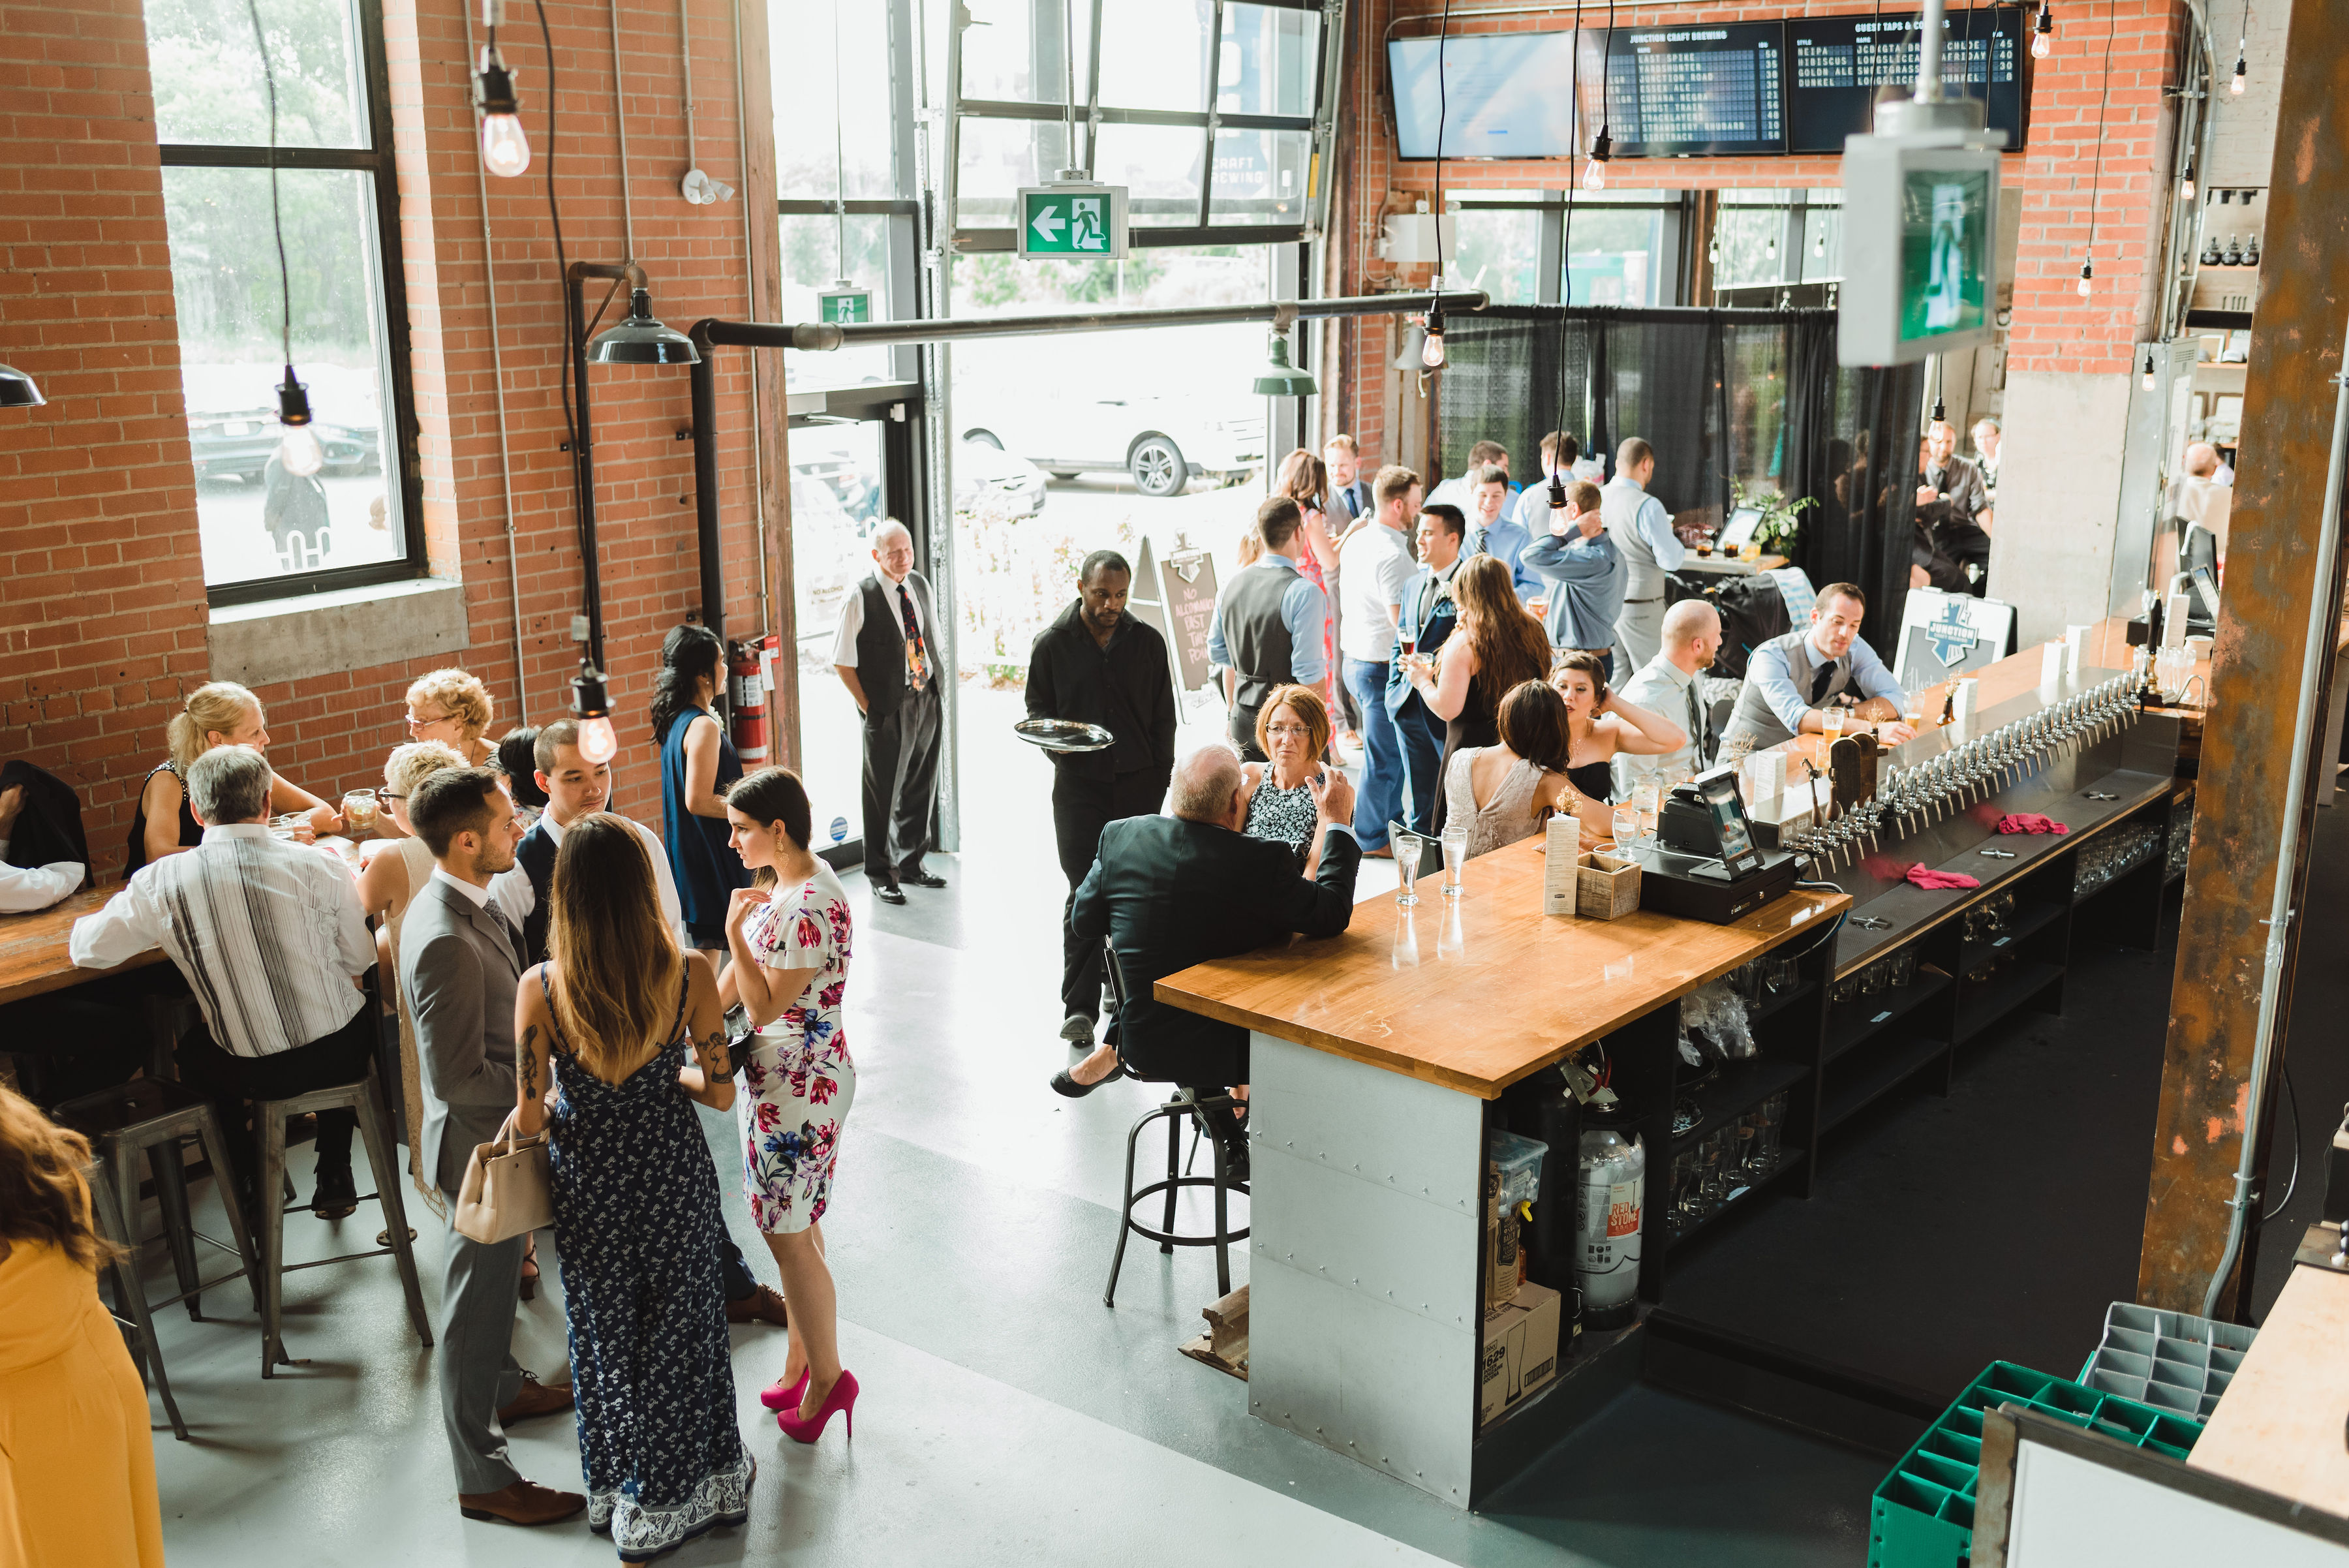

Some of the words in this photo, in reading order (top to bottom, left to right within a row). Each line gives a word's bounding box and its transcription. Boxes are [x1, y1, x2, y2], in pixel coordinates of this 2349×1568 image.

[1855, 22, 1882, 33] GUEST
[1883, 22, 1903, 31] TAPS
[1905, 21, 1912, 31] &
[1629, 33, 1665, 44] JUNCTION
[1666, 32, 1691, 42] CRAFT
[1691, 30, 1728, 41] BREWING
[1999, 40, 2013, 48] 45
[1798, 46, 1828, 56] NEIPA
[1999, 50, 2013, 59] 40
[1638, 54, 1661, 64] LAST
[1666, 53, 1695, 63] SPIKE
[1798, 57, 1847, 67] HIBISCUS
[1999, 61, 2013, 70] 30
[1798, 67, 1828, 77] GOLDN
[1835, 67, 1853, 76] ALE
[1639, 73, 1685, 84] JUNCTION
[1691, 72, 1713, 82] ROAD
[1798, 78, 1835, 87] DUNKEL
[1640, 84, 1668, 93] ESSEX
[1674, 83, 1691, 92] ALE
[1680, 93, 1708, 102] NEGRA
[1640, 104, 1669, 113] GHOST
[1676, 103, 1703, 112] TRAIN
[1642, 123, 1698, 132] STRAWBERRY
[1704, 121, 1745, 131] RHUBARB
[1642, 132, 1693, 142] SIDETRACK
[1212, 171, 1263, 183] REWING
[1183, 588, 1197, 601] NO
[1184, 614, 1205, 632] PAST
[1930, 623, 1974, 639] JUNCTION
[1612, 1201, 1629, 1214] RED
[1611, 1210, 1637, 1226] STONE
[1482, 1346, 1505, 1370] 1629
